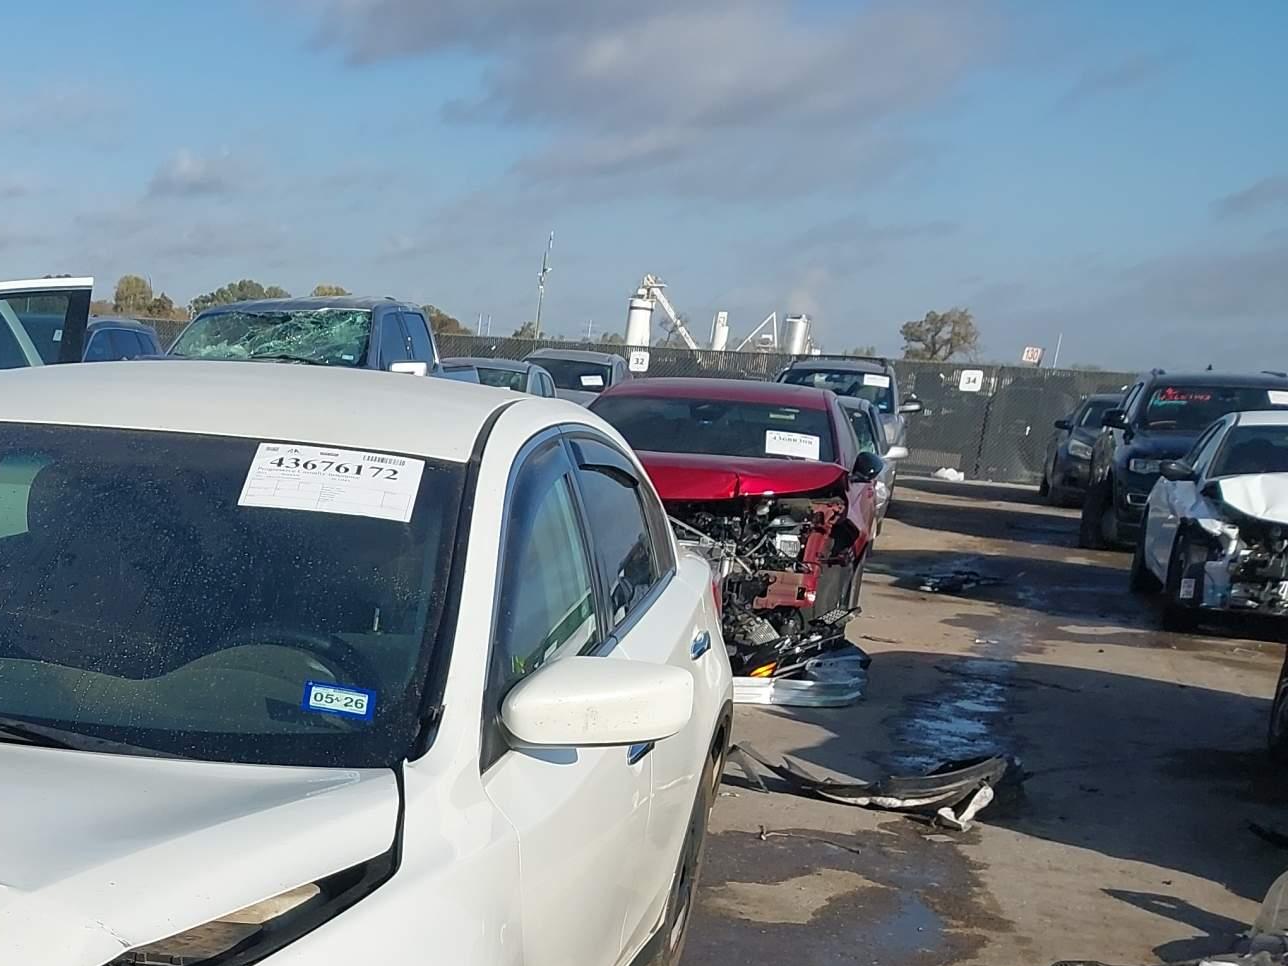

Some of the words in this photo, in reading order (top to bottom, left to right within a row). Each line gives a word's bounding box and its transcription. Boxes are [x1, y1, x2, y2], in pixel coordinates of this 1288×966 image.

[633, 357, 645, 366] 32
[964, 376, 977, 385] 34
[269, 456, 400, 481] 43676172
